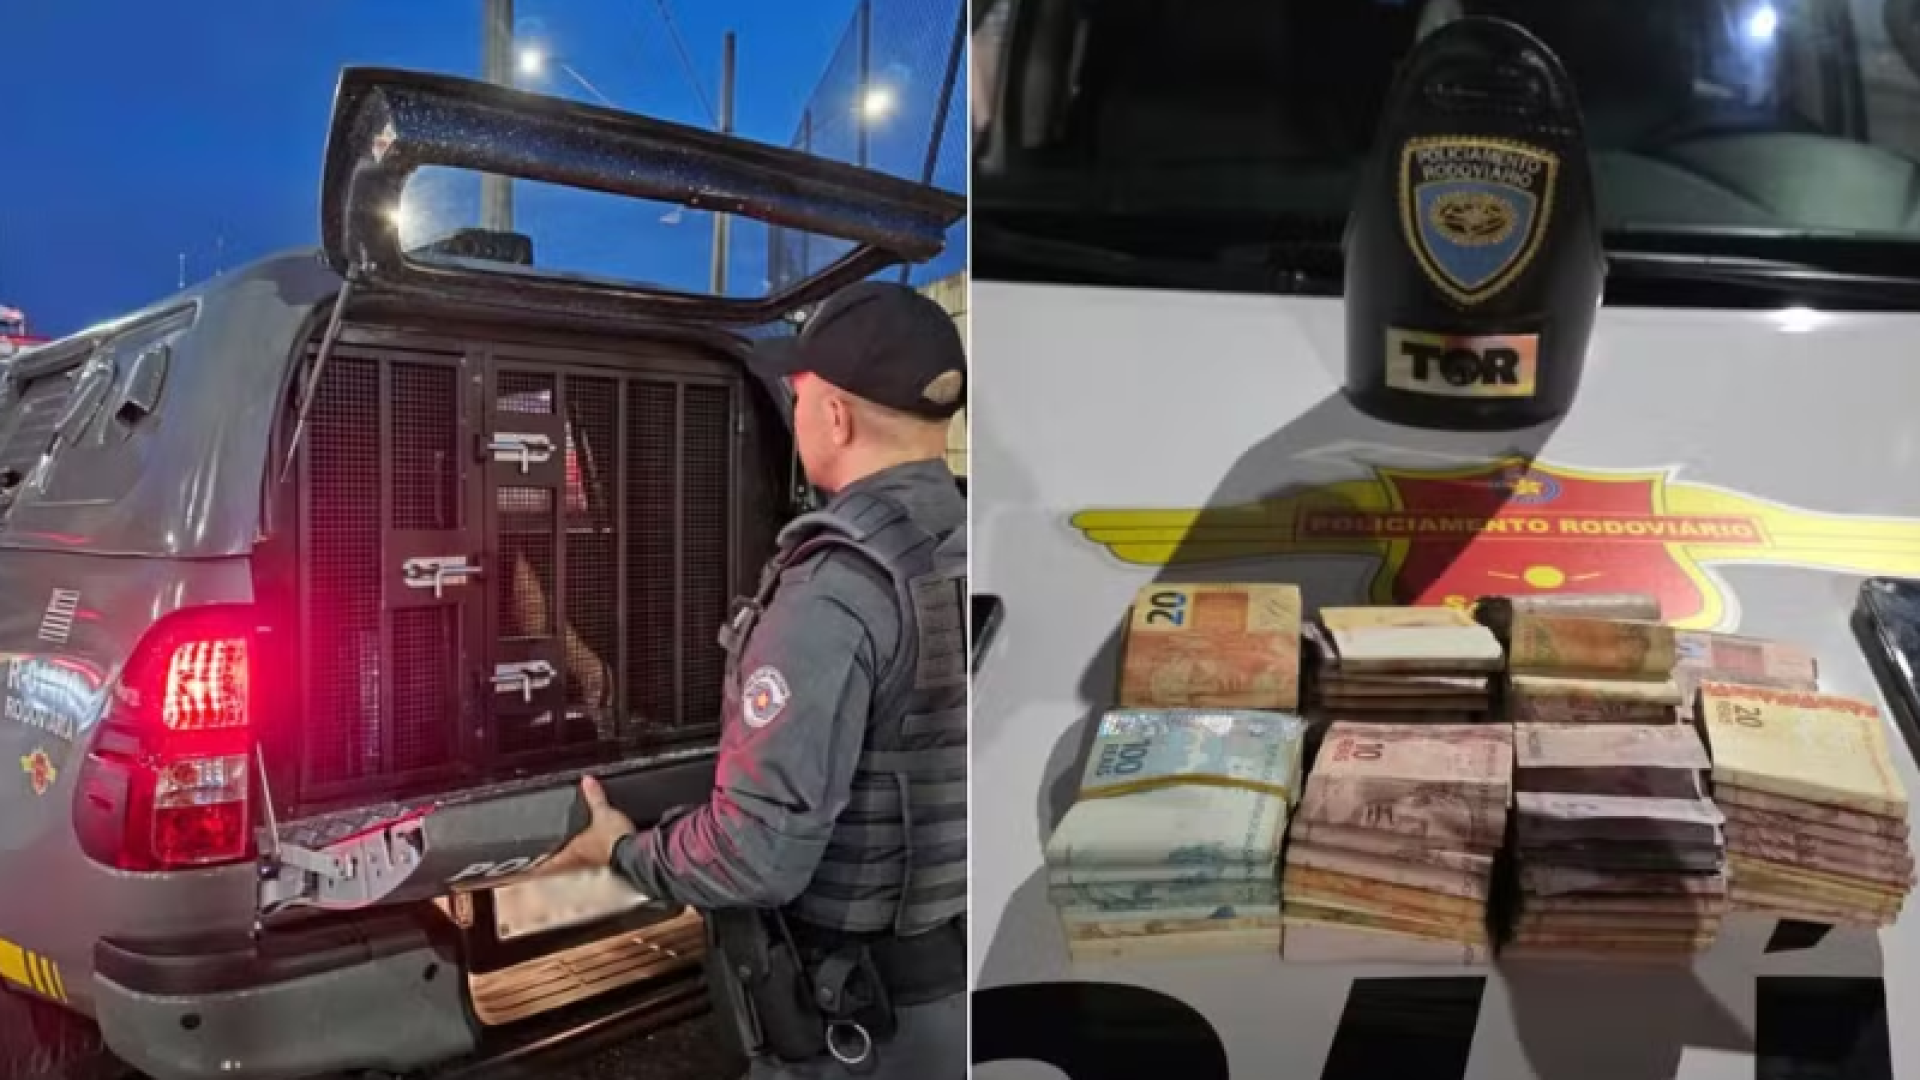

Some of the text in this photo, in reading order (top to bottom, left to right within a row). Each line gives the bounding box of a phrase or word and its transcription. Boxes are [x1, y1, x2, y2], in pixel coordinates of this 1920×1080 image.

[1417, 147, 1543, 174] POLICIAMENTO
[1401, 340, 1521, 387] TOR
[1310, 516, 1757, 539] POLICIAMENTO RODOVIÁRIO
[1146, 592, 1187, 627] 20
[1735, 705, 1762, 727] 20
[1115, 737, 1153, 775] 100
[1353, 742, 1385, 761] 10
